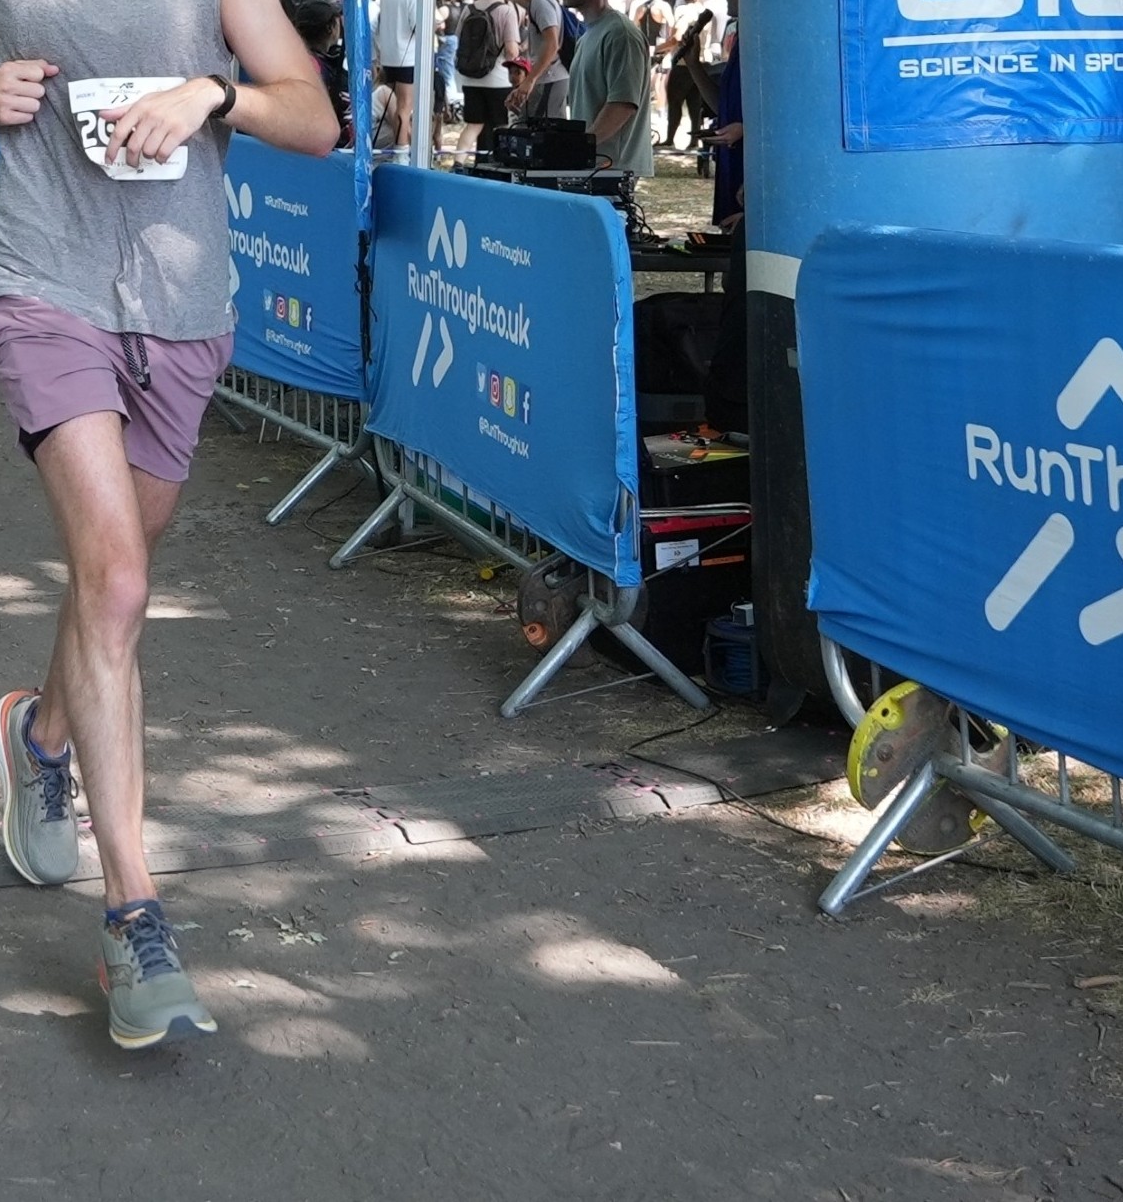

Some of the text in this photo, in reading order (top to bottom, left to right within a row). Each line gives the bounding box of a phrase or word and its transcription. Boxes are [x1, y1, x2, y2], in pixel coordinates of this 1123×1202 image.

[899, 54, 1039, 79] SCIENCE
[1050, 53, 1076, 73] IN
[481, 236, 532, 267] #RunThroughUK
[407, 261, 531, 350] RunThrough.co.uk
[478, 415, 530, 460] @RunThroughUK
